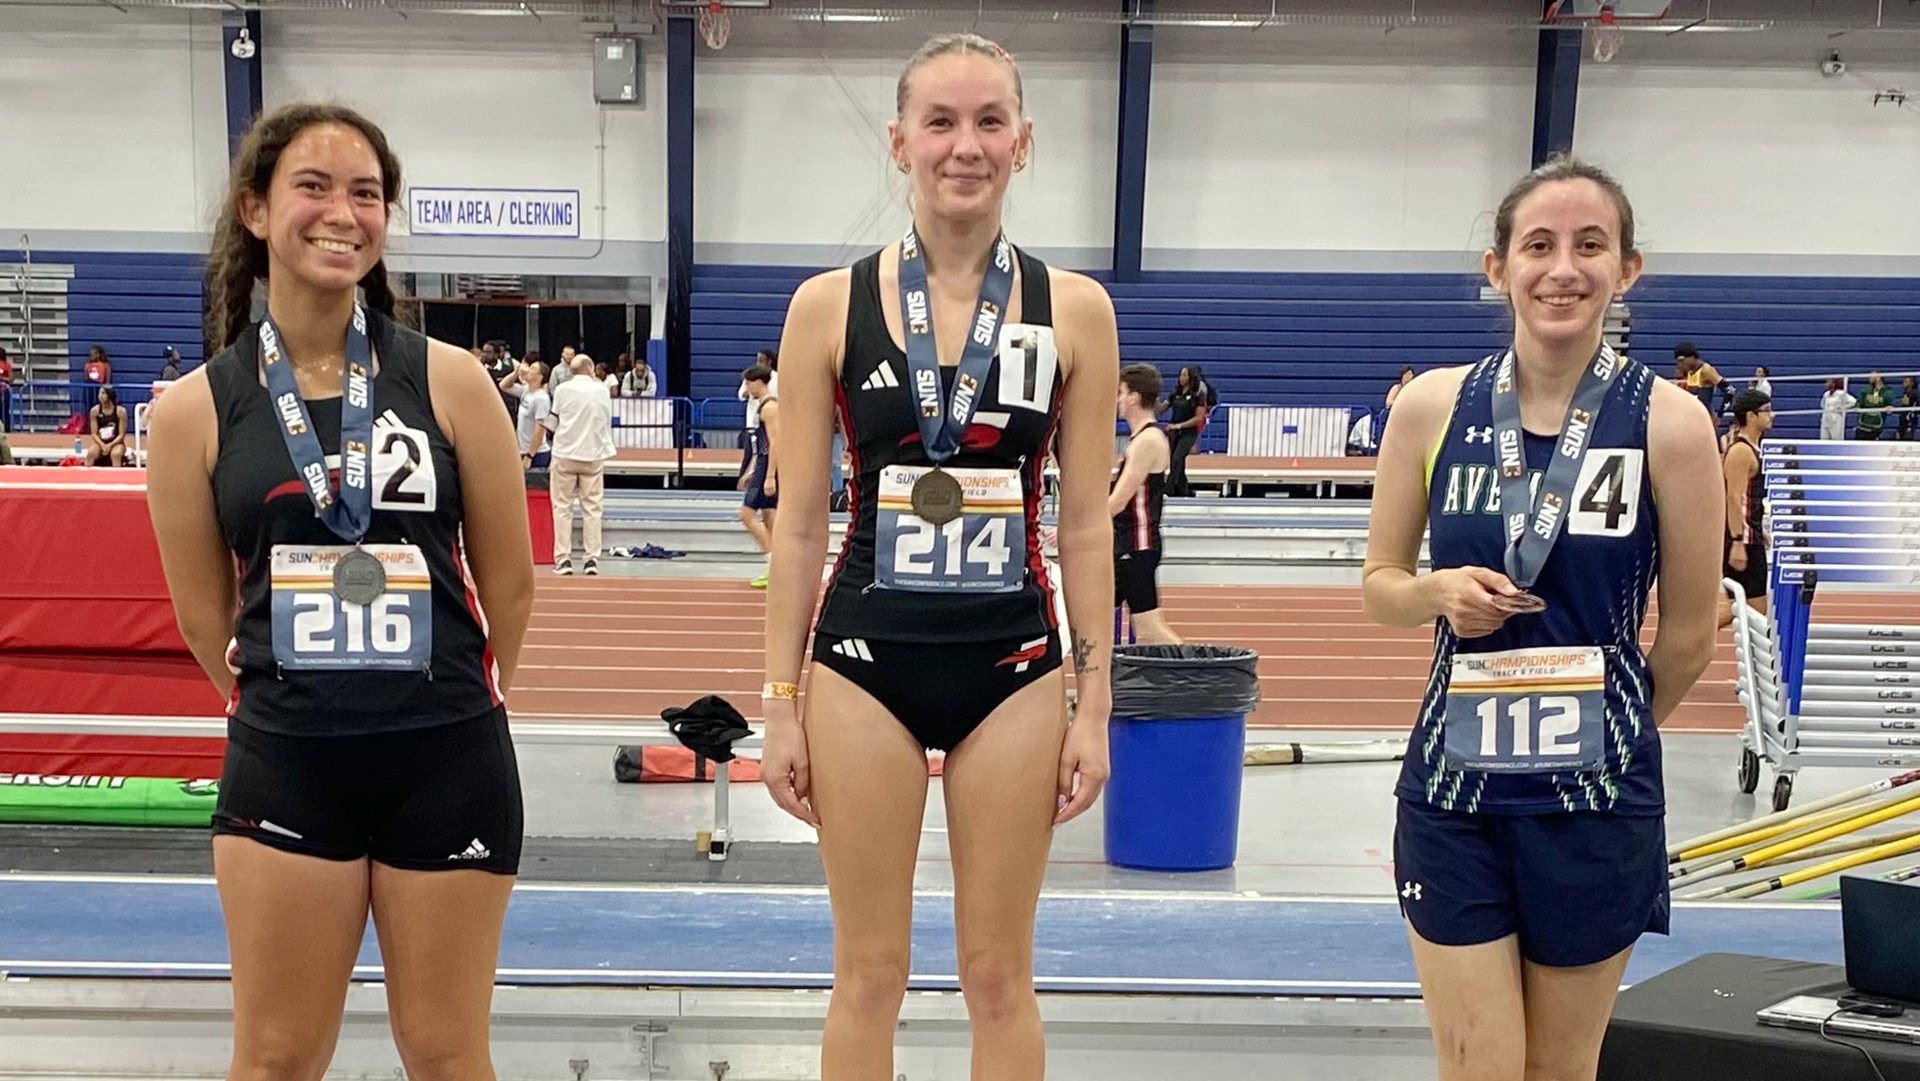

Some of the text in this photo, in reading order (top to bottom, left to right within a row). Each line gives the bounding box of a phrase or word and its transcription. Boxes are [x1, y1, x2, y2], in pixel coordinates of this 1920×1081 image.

[417, 199, 573, 227] TEAM AREA / CLERKING
[1010, 331, 1038, 402] 1
[1593, 340, 1617, 381] SUN
[379, 432, 426, 505] 2
[1578, 454, 1629, 530] 4
[894, 514, 1011, 575] 214
[293, 592, 412, 652] 216
[1873, 661, 1908, 669] UCS
[1878, 691, 1913, 699] UCS
[1477, 696, 1581, 756] 112
[1881, 721, 1916, 729] UCS
